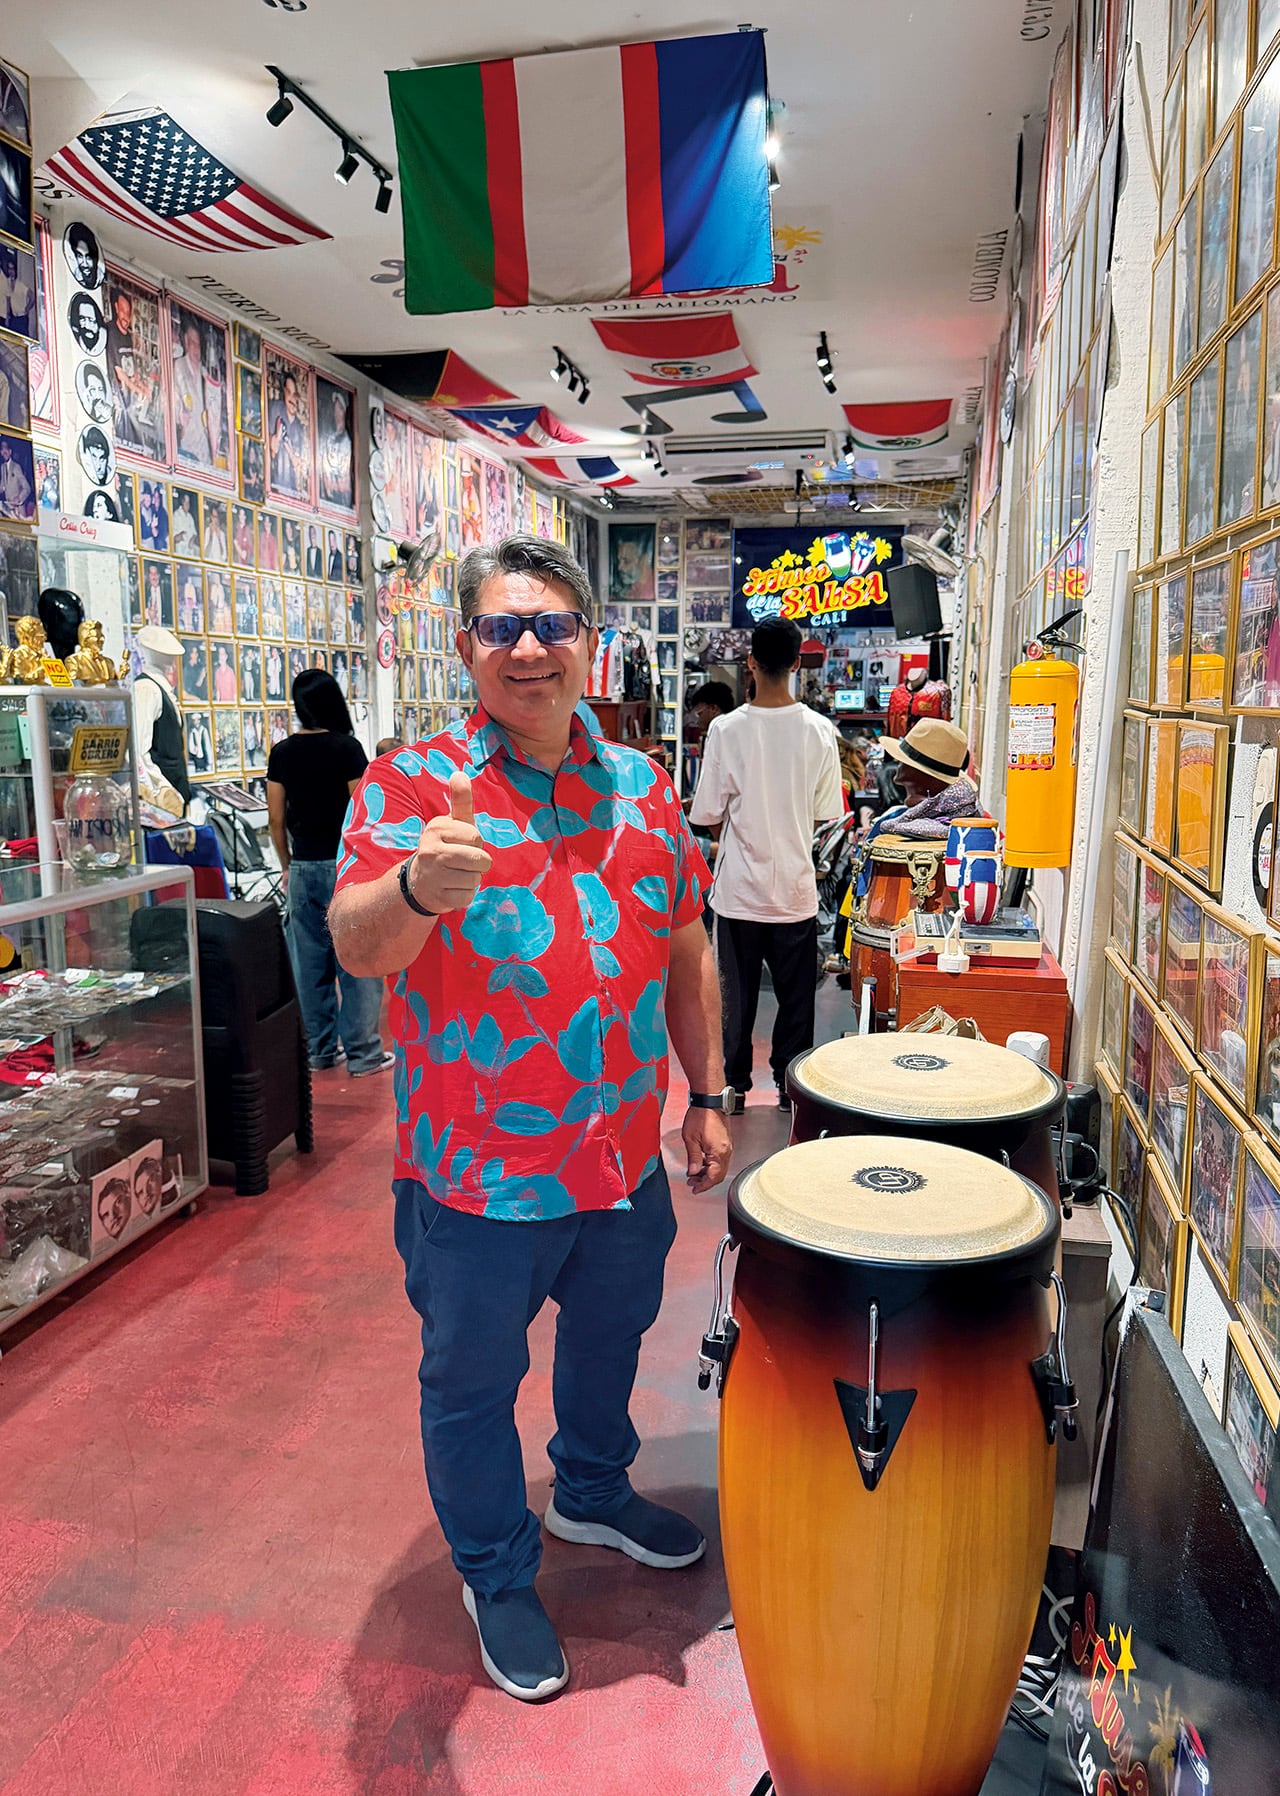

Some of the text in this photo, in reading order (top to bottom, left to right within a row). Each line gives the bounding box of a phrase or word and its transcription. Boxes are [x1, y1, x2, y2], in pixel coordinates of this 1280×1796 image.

[968, 229, 1008, 302] COLOMBIA
[185, 275, 331, 349] PUERTO RICO
[536, 305, 592, 314] CASA
[603, 303, 645, 311] DEL
[655, 294, 798, 308] MELOMANO
[742, 563, 832, 597] Museo
[780, 571, 888, 620] SALSA
[810, 611, 848, 627] CALI
[46, 663, 63, 673] NO
[82, 738, 121, 750] BARRIO
